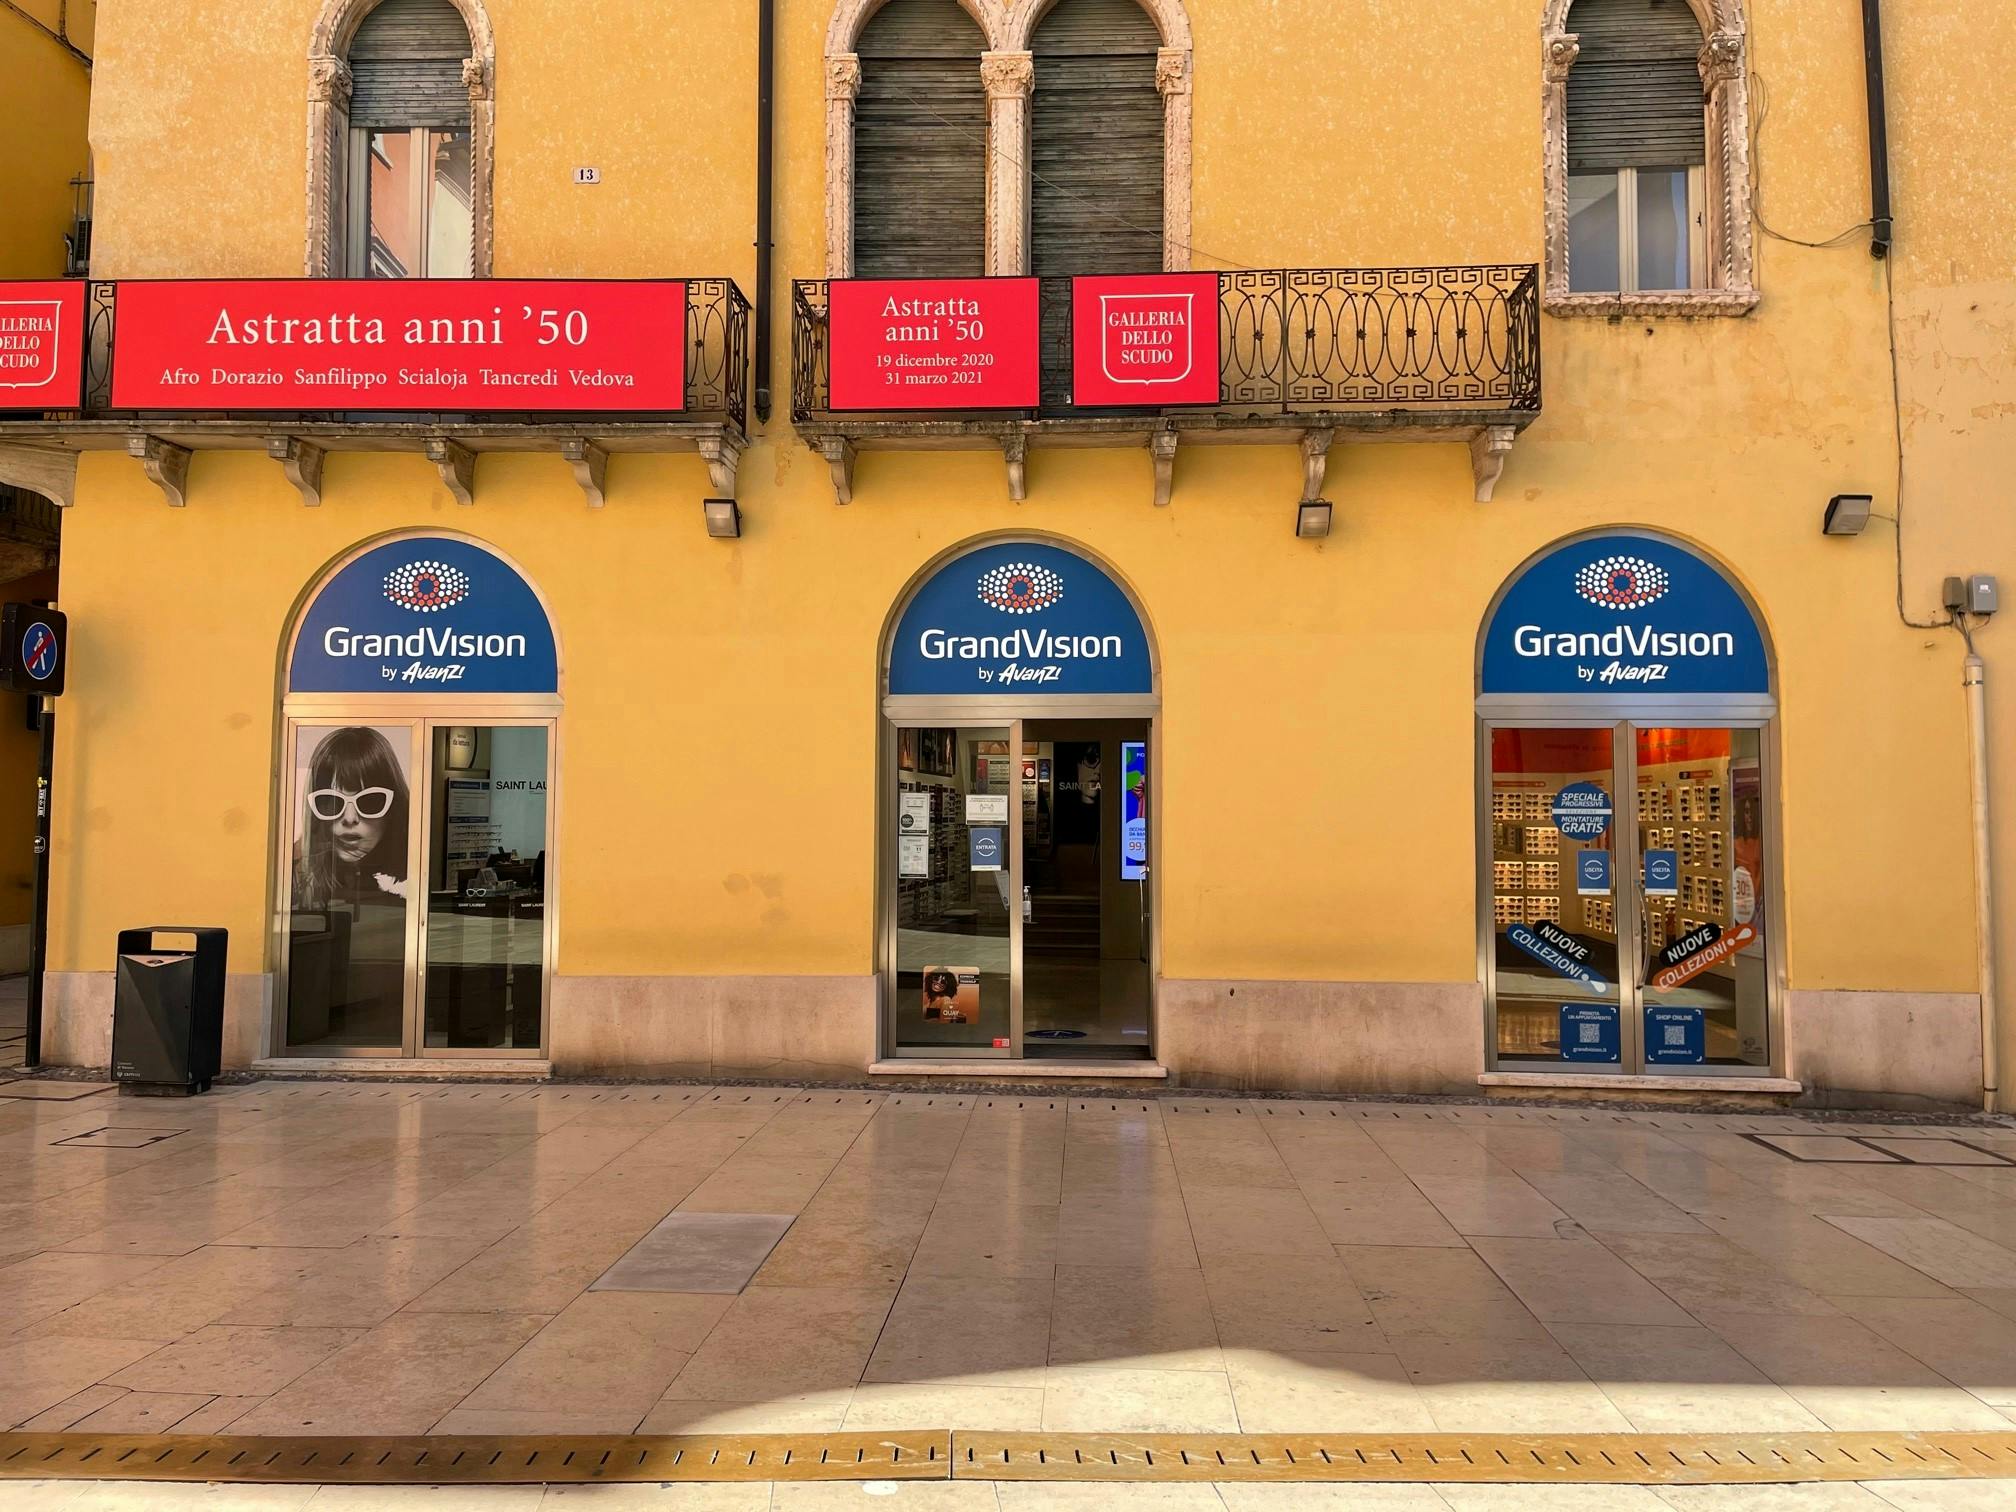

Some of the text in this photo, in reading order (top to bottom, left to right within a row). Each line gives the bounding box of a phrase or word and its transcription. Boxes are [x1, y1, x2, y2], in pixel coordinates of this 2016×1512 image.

[580, 169, 593, 180] 13
[882, 296, 980, 317] Astratta
[0, 317, 53, 332] LLERIA
[206, 308, 386, 345] Astratta
[403, 307, 504, 345] anni
[1109, 311, 1185, 327] GALLERIA
[886, 319, 939, 341] anni
[1122, 330, 1173, 346] DELLO
[0, 353, 40, 368] CUDO
[877, 353, 994, 367] 19 dicembre 2020
[1121, 349, 1173, 365] SCUDO
[160, 367, 635, 391] Afro Dorazio Sanfilippo Scialoja Tancredi Vedova
[885, 371, 983, 386] 31 marzo 2021
[324, 626, 526, 657] GrandVision
[920, 629, 1122, 659] GrandVision
[1514, 625, 1734, 657] GrandVision
[382, 665, 398, 681] by
[978, 667, 994, 683] by
[1577, 664, 1595, 682] by
[495, 781, 526, 790] SAINT
[1562, 793, 1604, 801] SPECIALE
[1561, 823, 1604, 833] GRATIS
[1540, 925, 1589, 960] NUOVE
[1667, 928, 1713, 963] NUOVE
